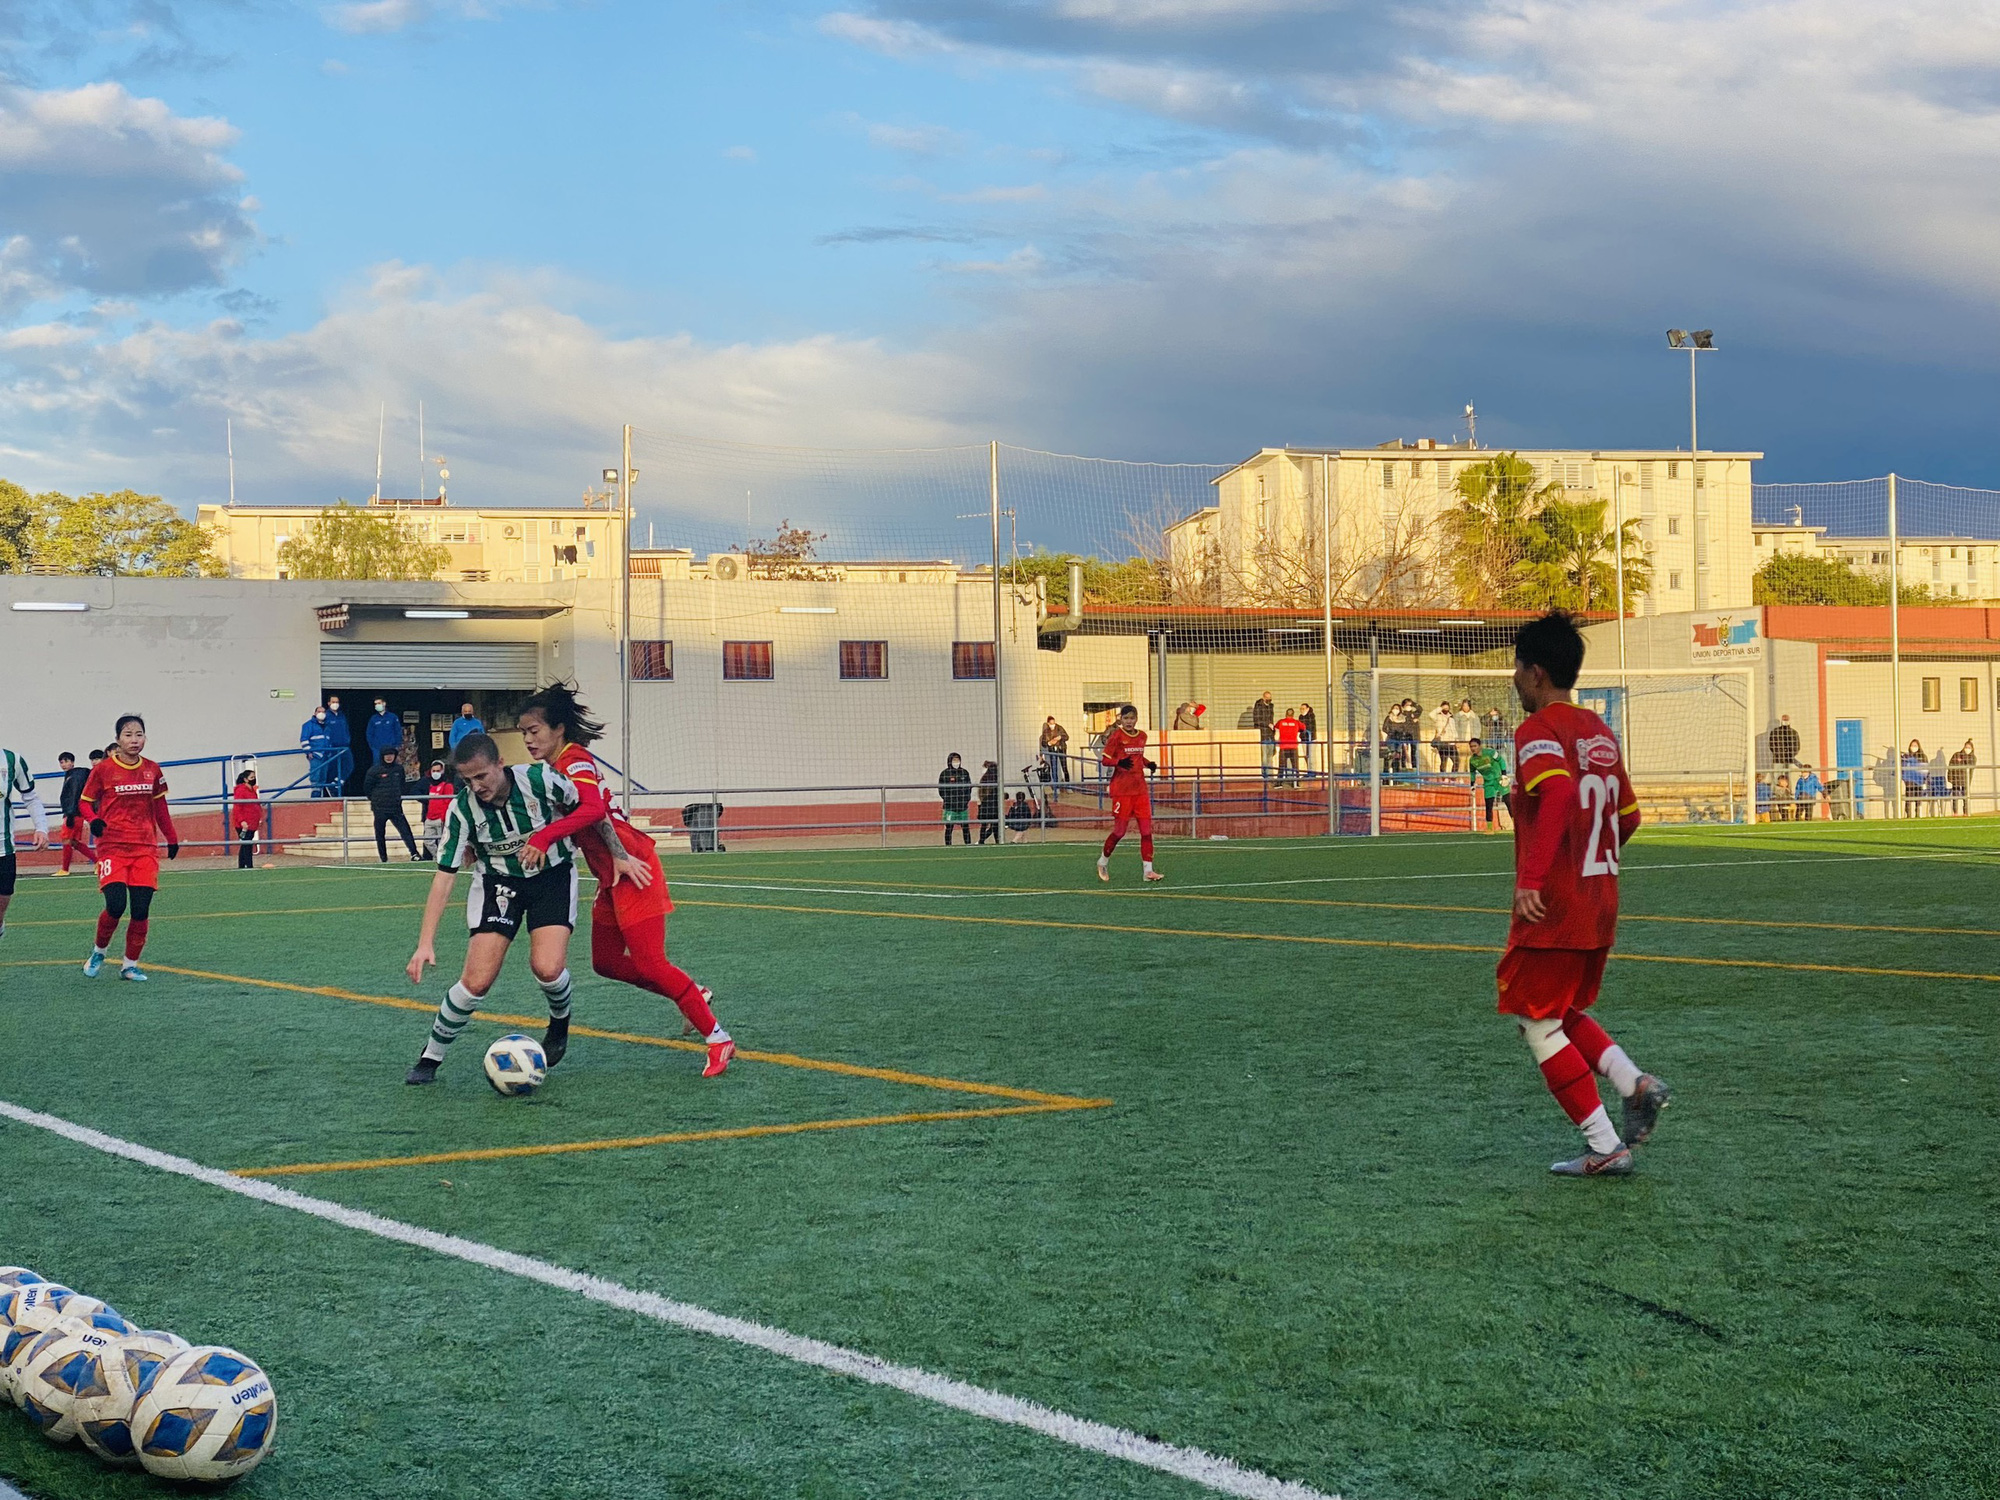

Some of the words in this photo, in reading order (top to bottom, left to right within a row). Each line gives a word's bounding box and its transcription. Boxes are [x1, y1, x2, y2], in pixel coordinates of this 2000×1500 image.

[1713, 648, 1745, 657] DEPORTIVA
[1114, 802, 1121, 814] 2
[1579, 774, 1620, 877] 23
[489, 839, 526, 851] PIEDRA
[24, 1287, 38, 1311] olten
[231, 1381, 269, 1405] molten
